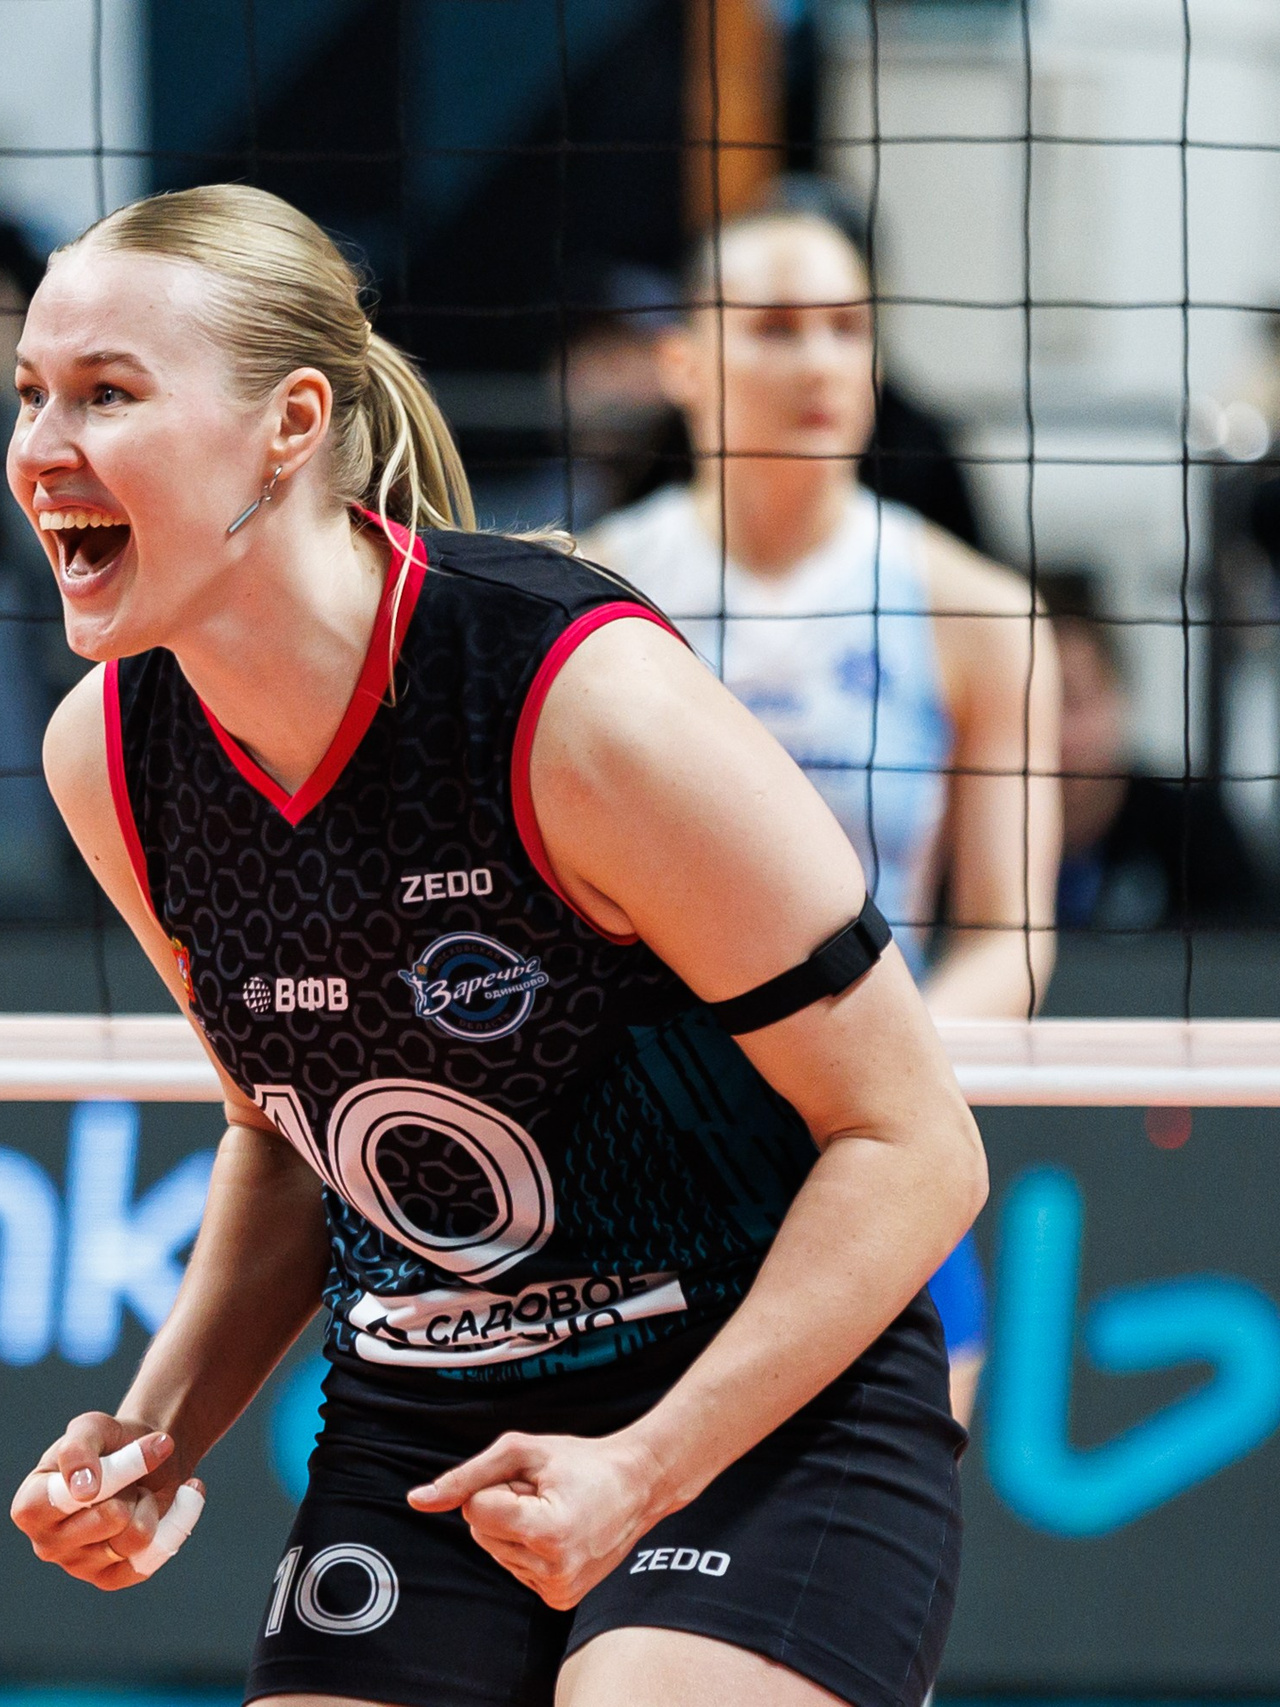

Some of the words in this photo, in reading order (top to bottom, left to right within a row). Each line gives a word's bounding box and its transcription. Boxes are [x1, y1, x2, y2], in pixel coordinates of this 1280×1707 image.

[400, 868, 494, 903] ZEDO
[275, 977, 349, 1013] ВФВ
[422, 959, 538, 1016] Заречье
[254, 1078, 555, 1284] 10
[425, 1274, 647, 1346] САДОВОЕ
[265, 1542, 400, 1638] 10
[629, 1547, 732, 1577] ZEDO
